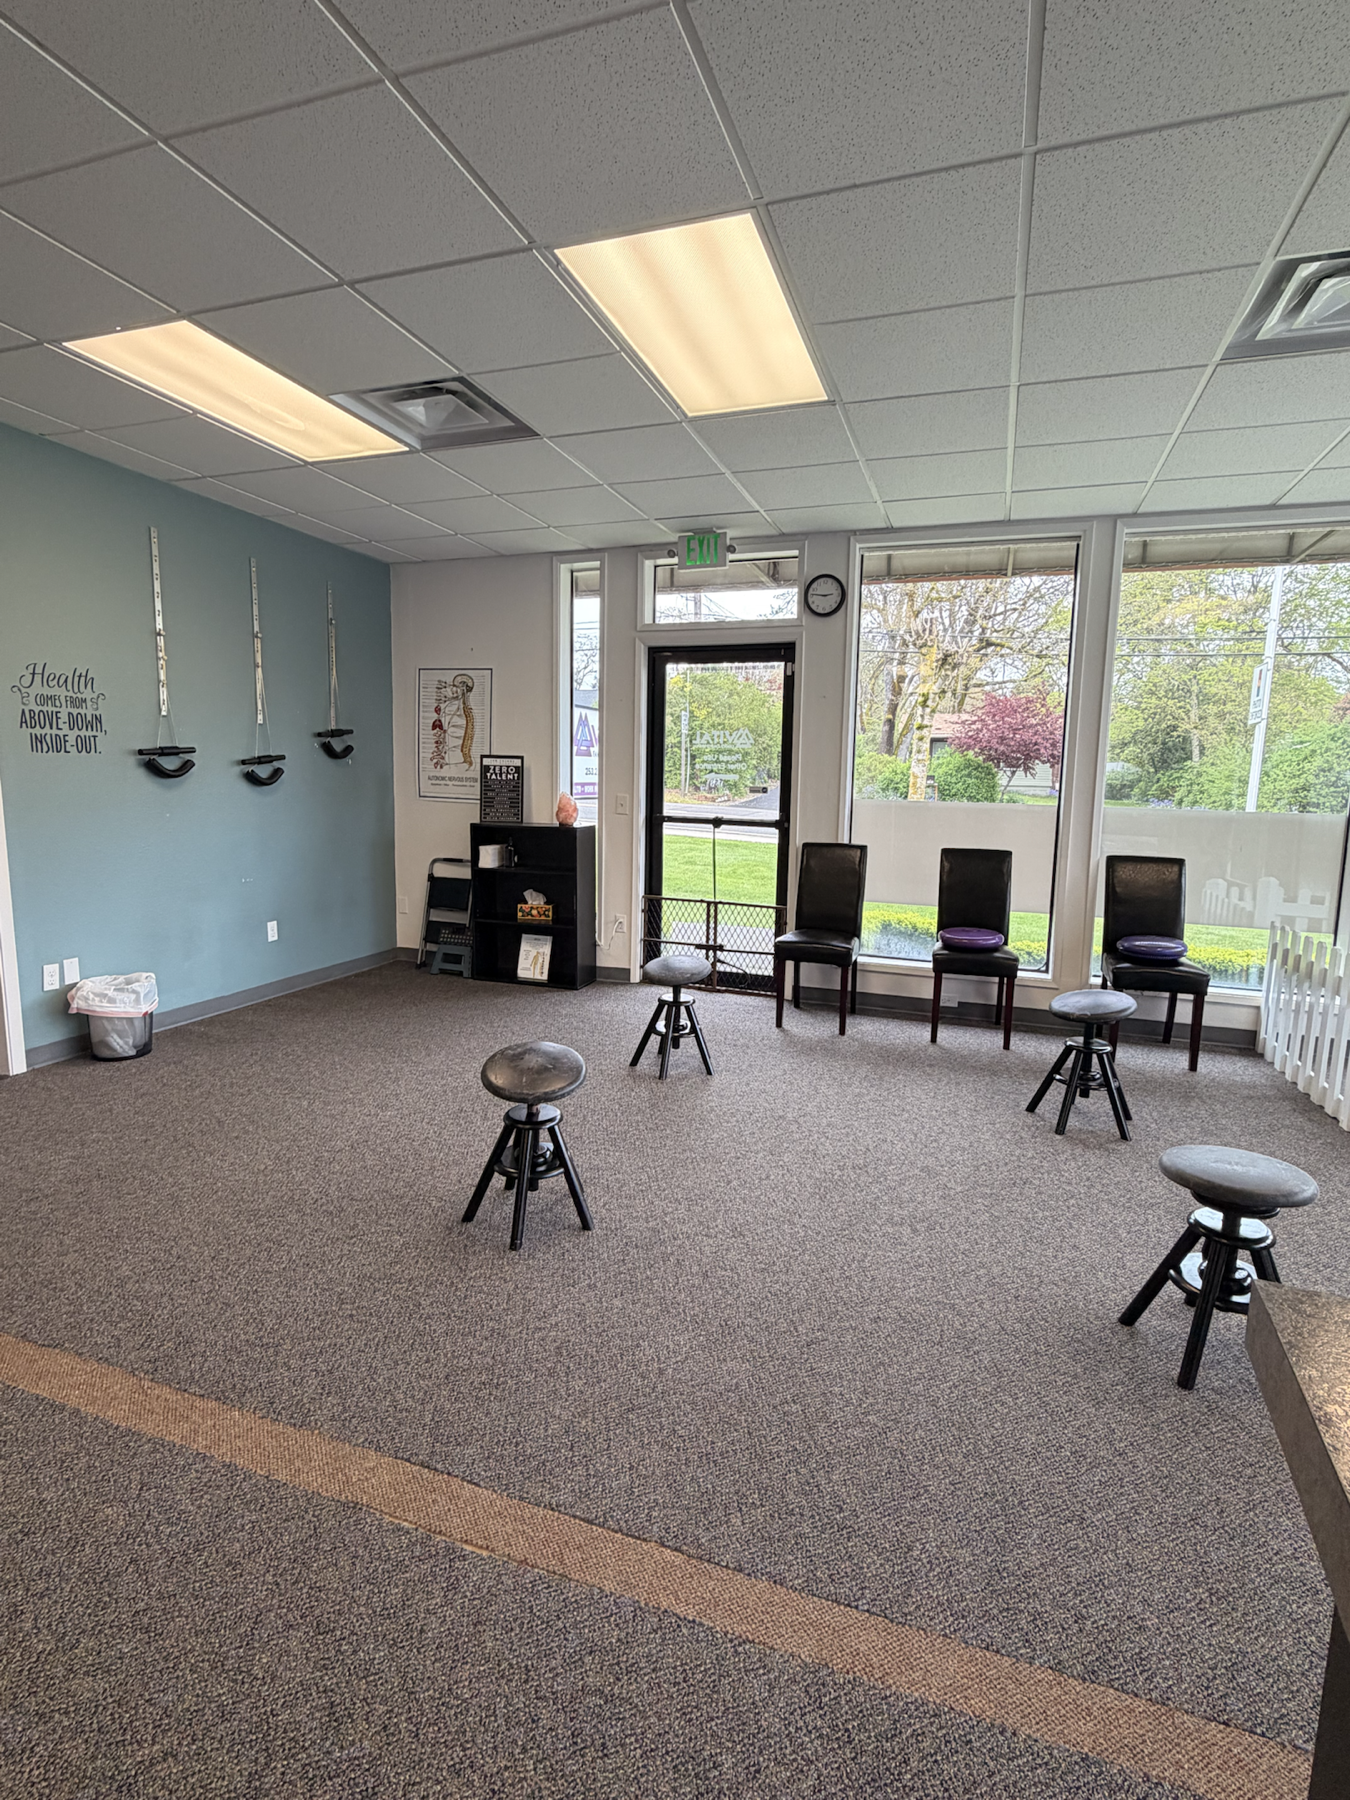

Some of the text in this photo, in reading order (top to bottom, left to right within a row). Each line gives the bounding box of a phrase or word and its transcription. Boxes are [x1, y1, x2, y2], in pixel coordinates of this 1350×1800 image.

[686, 534, 720, 565] EXIT
[19, 662, 95, 694] Health
[34, 692, 88, 710] COMES FROM
[20, 708, 107, 736] ABOVE-DOWN,
[30, 732, 102, 754] INSIDE-OUT.
[489, 766, 516, 774] ZERO
